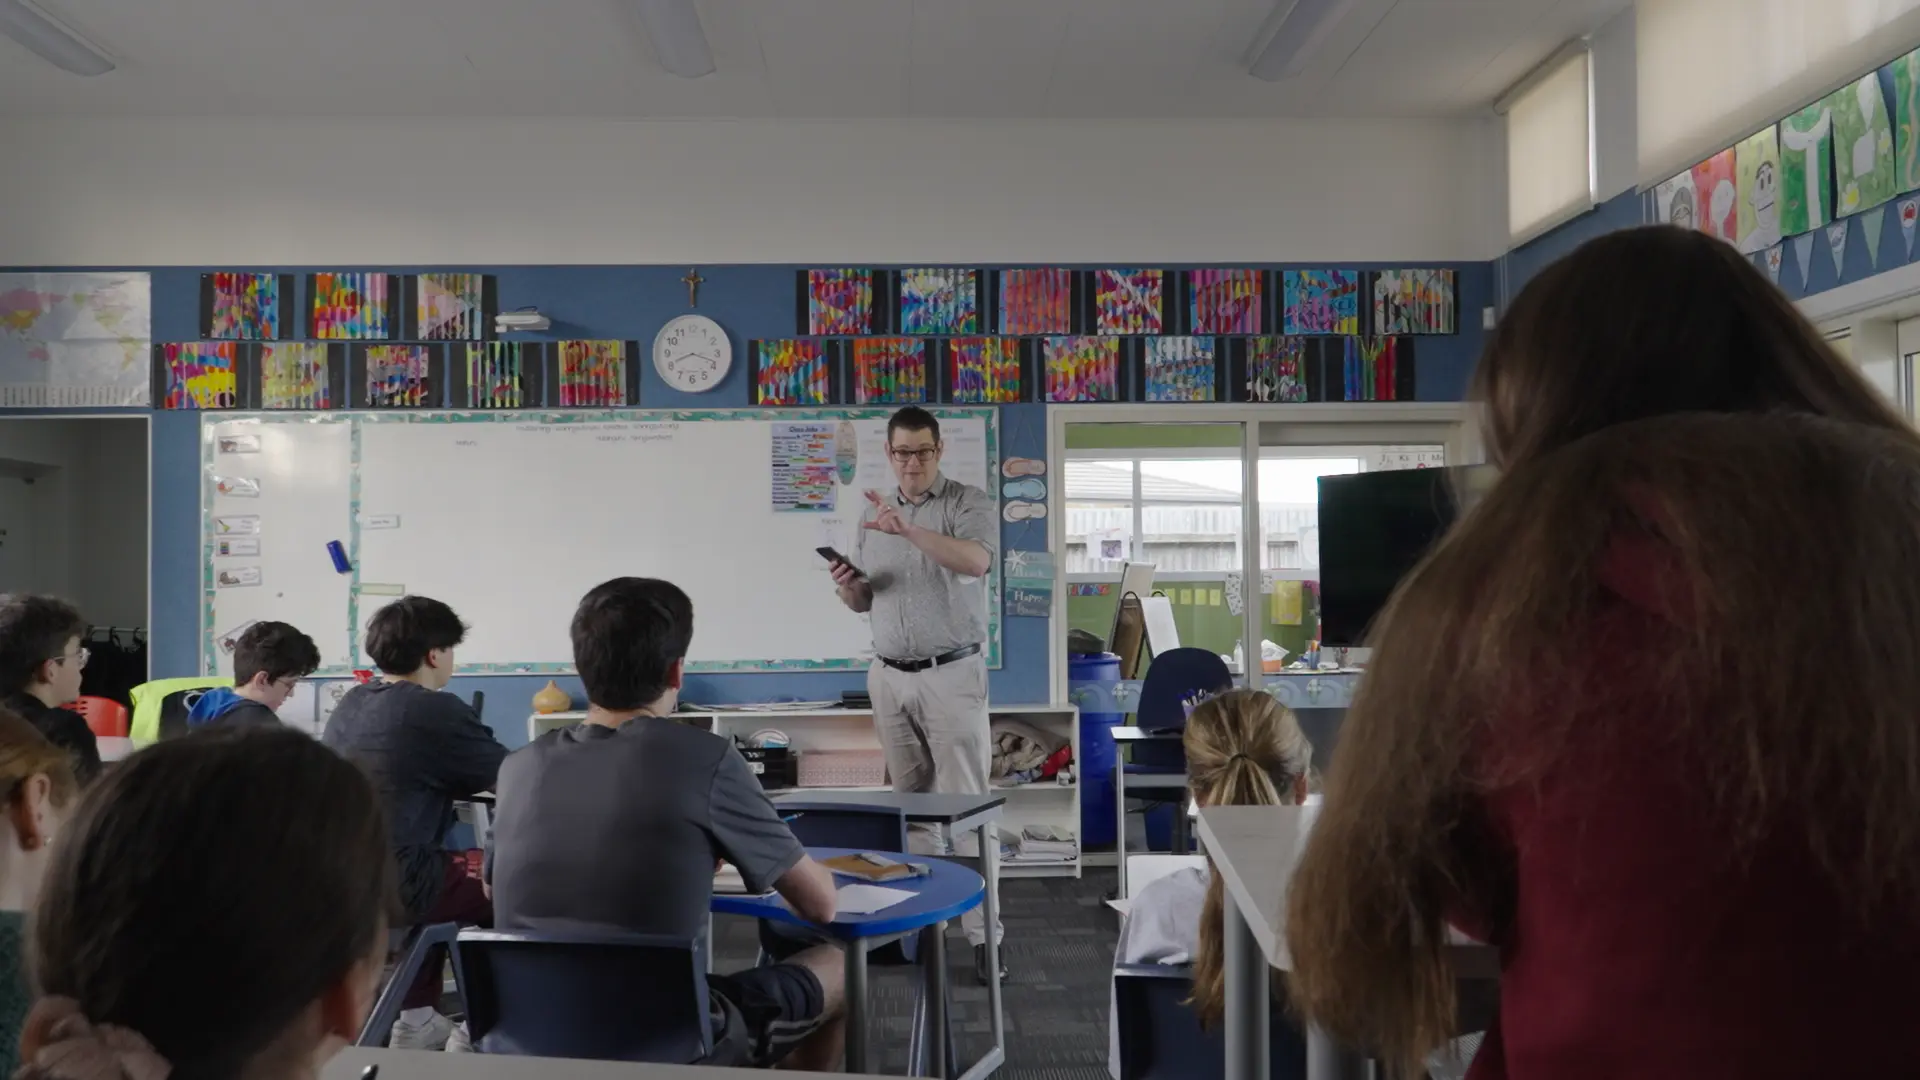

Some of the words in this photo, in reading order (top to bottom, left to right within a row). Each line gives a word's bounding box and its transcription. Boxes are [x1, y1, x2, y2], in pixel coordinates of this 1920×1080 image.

[675, 328, 685, 337] 11
[688, 324, 698, 333] 12
[702, 328, 707, 338] 1
[666, 336, 678, 346] 10
[710, 336, 717, 346] 2
[664, 348, 671, 358] 9
[714, 349, 721, 358] 3
[668, 361, 674, 371] 8
[710, 361, 717, 371] 4
[677, 371, 684, 380] 7
[689, 374, 696, 385] 6
[701, 371, 708, 380] 5
